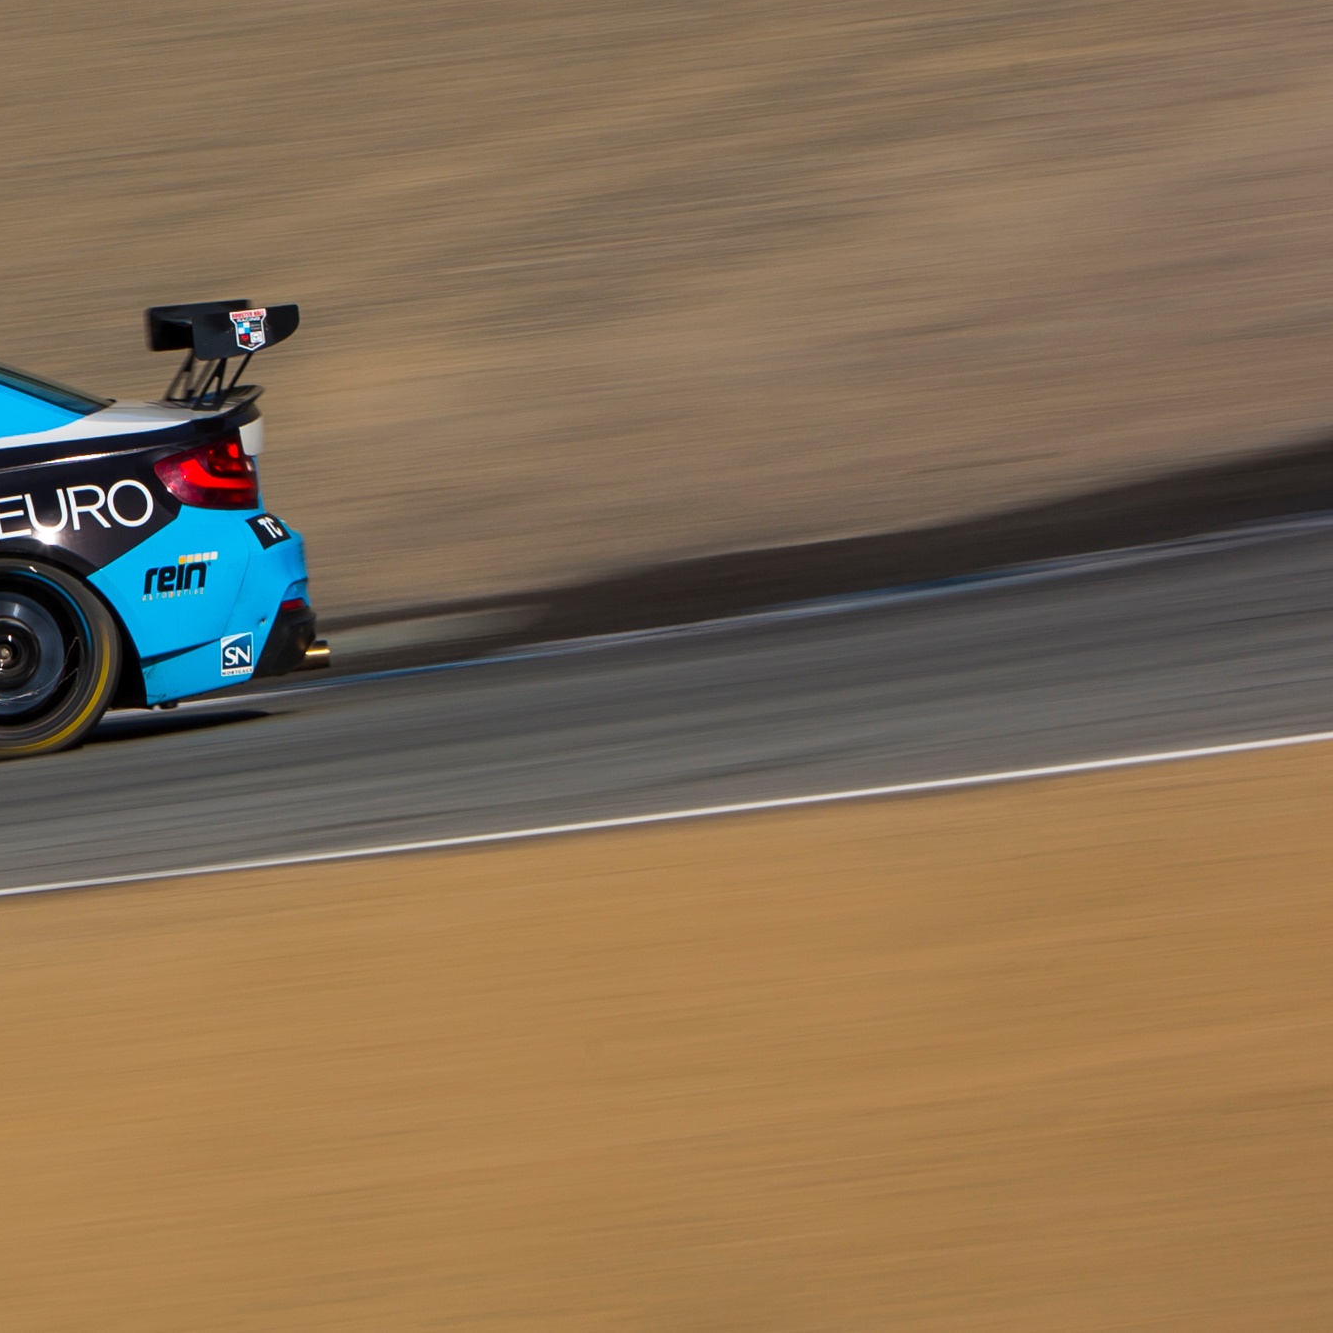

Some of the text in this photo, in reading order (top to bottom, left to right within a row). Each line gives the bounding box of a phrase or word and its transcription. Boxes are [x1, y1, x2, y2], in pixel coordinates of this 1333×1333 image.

[257, 516, 284, 539] TC
[144, 557, 208, 595] rein
[224, 645, 251, 666] SN
